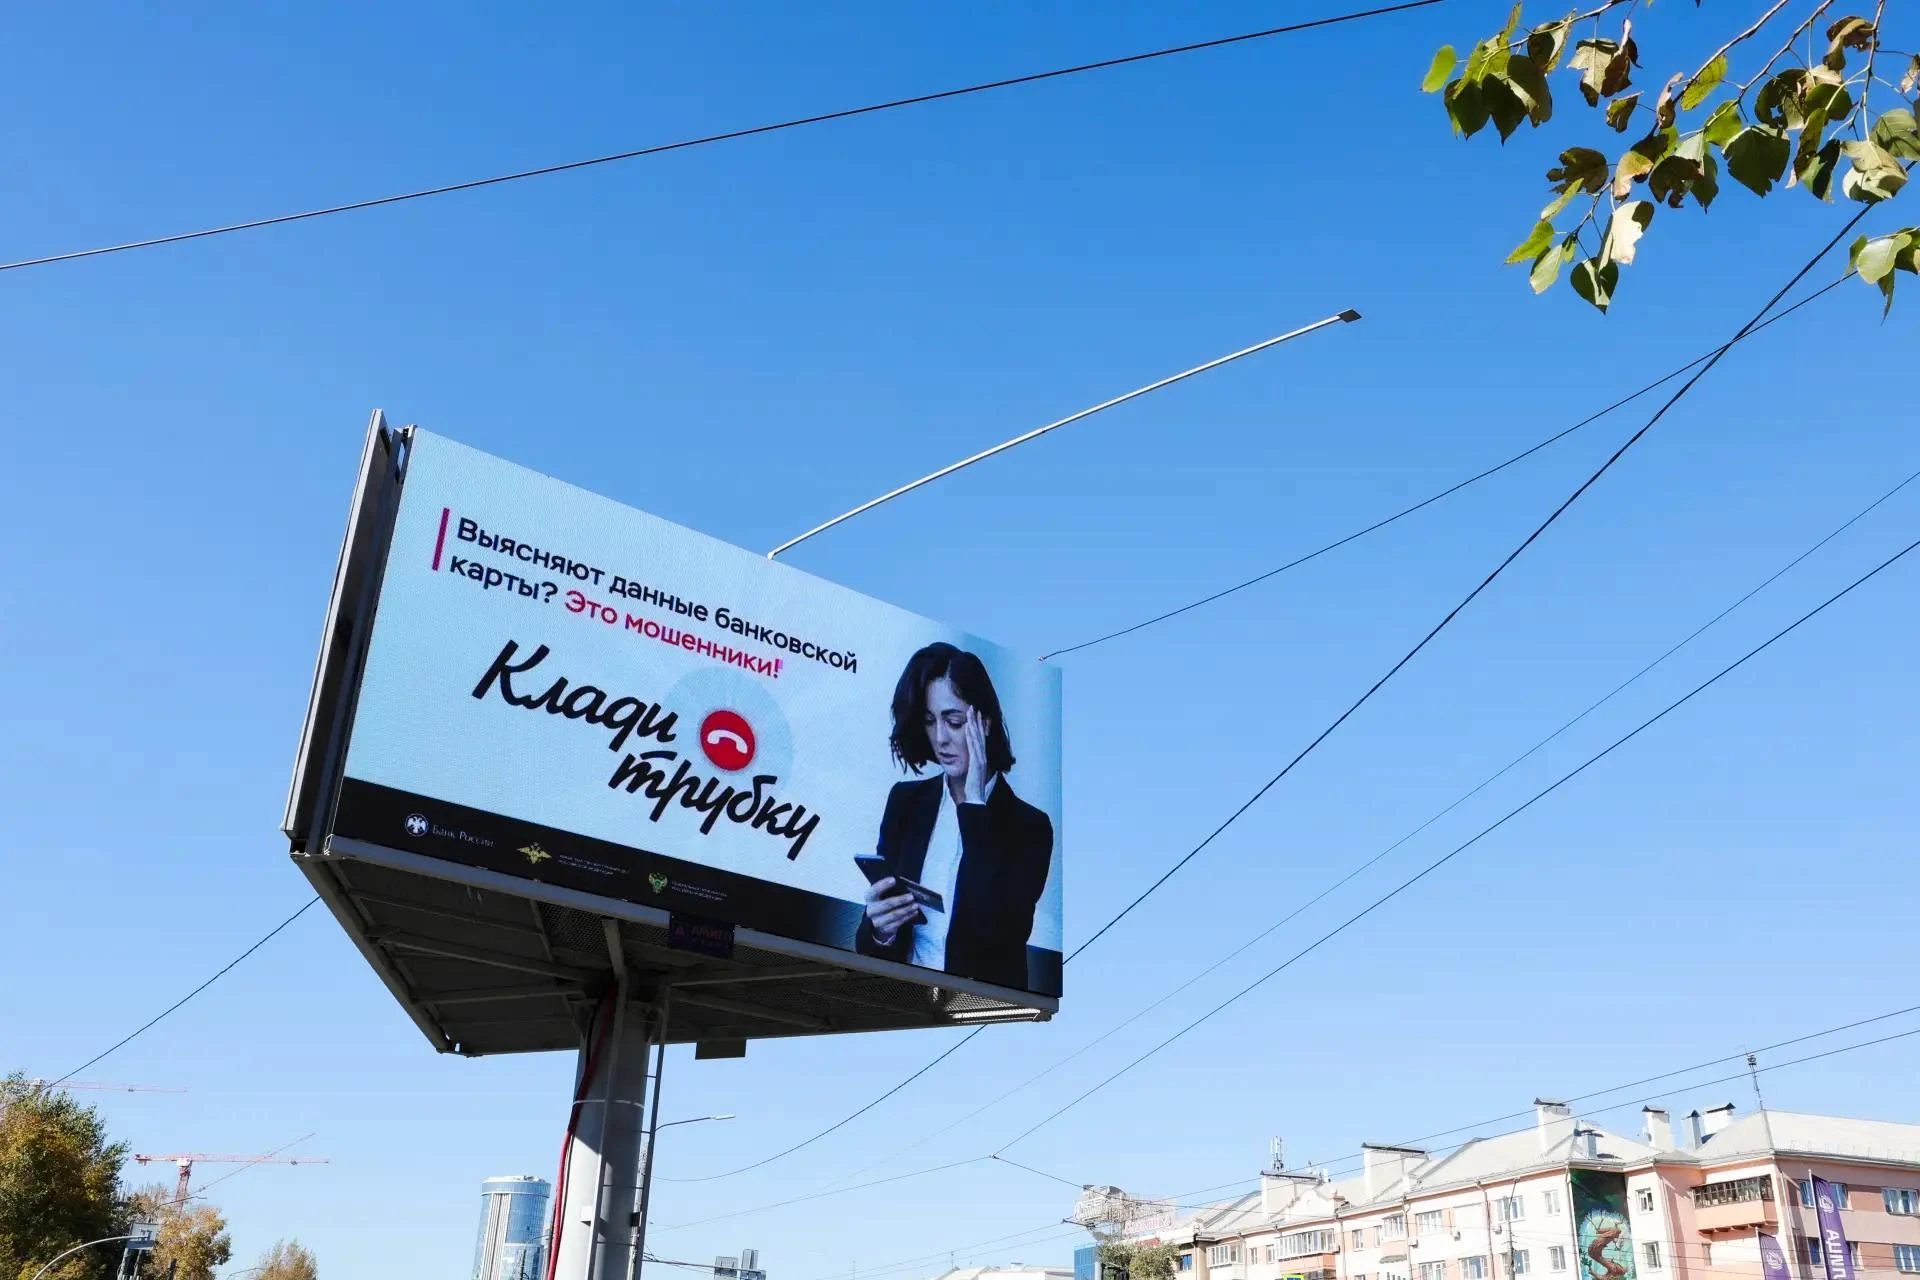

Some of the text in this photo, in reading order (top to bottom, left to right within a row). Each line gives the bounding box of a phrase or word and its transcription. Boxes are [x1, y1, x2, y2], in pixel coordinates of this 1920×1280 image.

[449, 555, 783, 679] карты? Это мошенники!
[457, 517, 858, 674] Выясняют данные банковской
[472, 639, 679, 752] Клади
[608, 750, 821, 861] трубку
